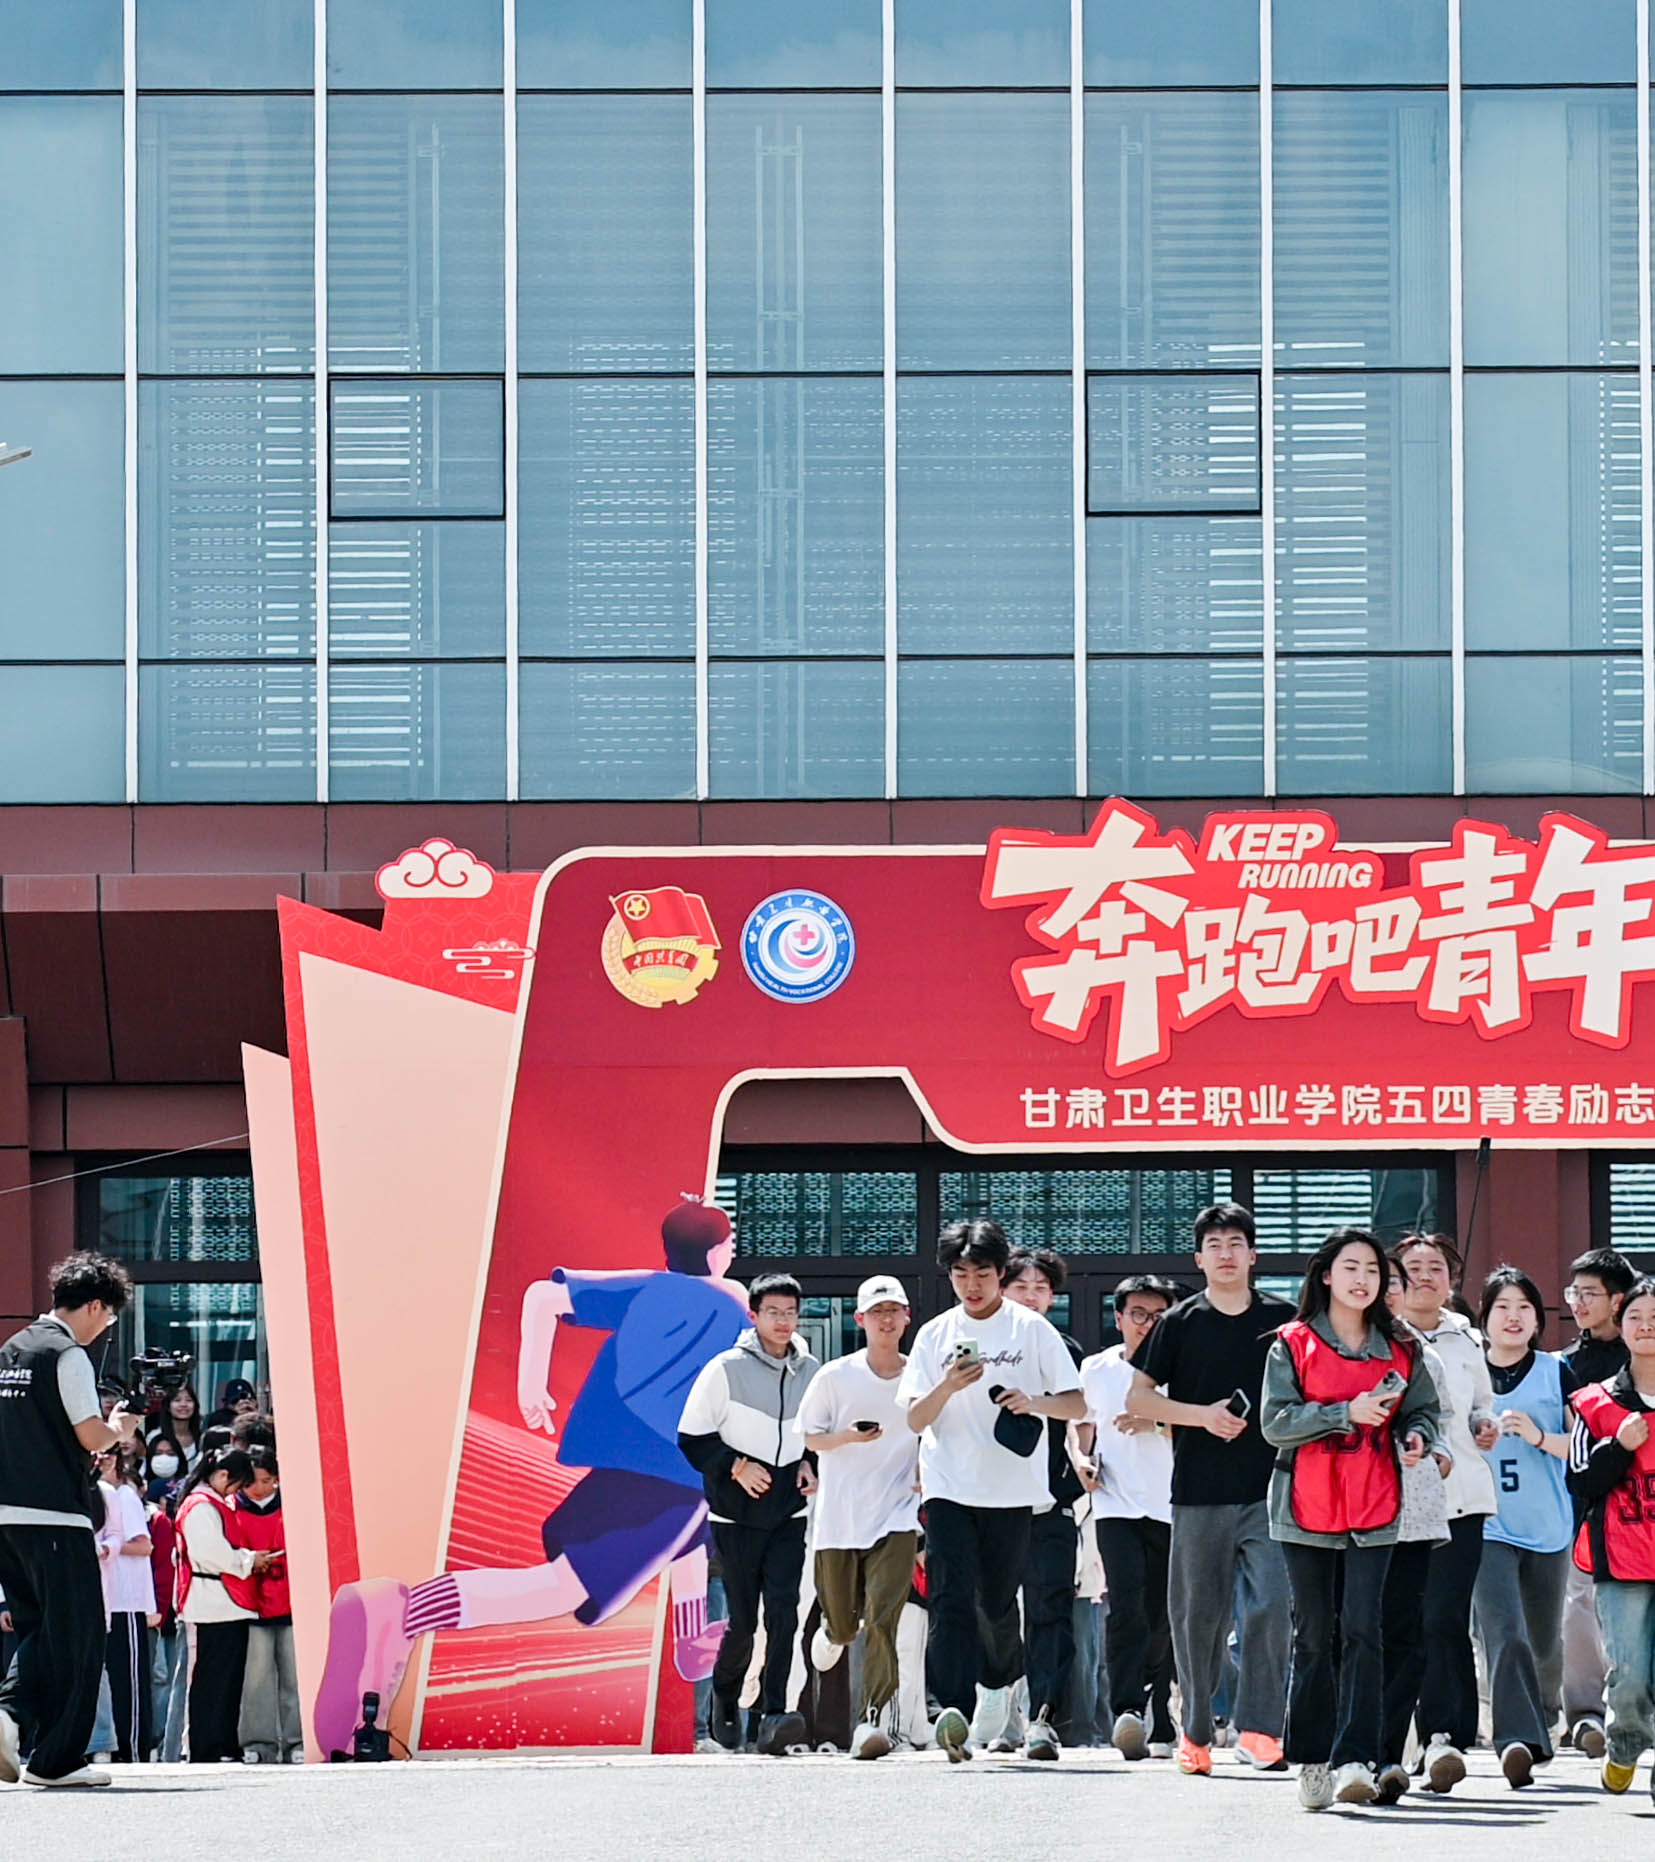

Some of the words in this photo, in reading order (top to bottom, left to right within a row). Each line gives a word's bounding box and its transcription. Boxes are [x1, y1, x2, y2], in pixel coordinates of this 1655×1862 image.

[1206, 823, 1326, 861] KEEP
[1237, 862, 1374, 889] RUNNING
[1500, 1458, 1520, 1492] 5
